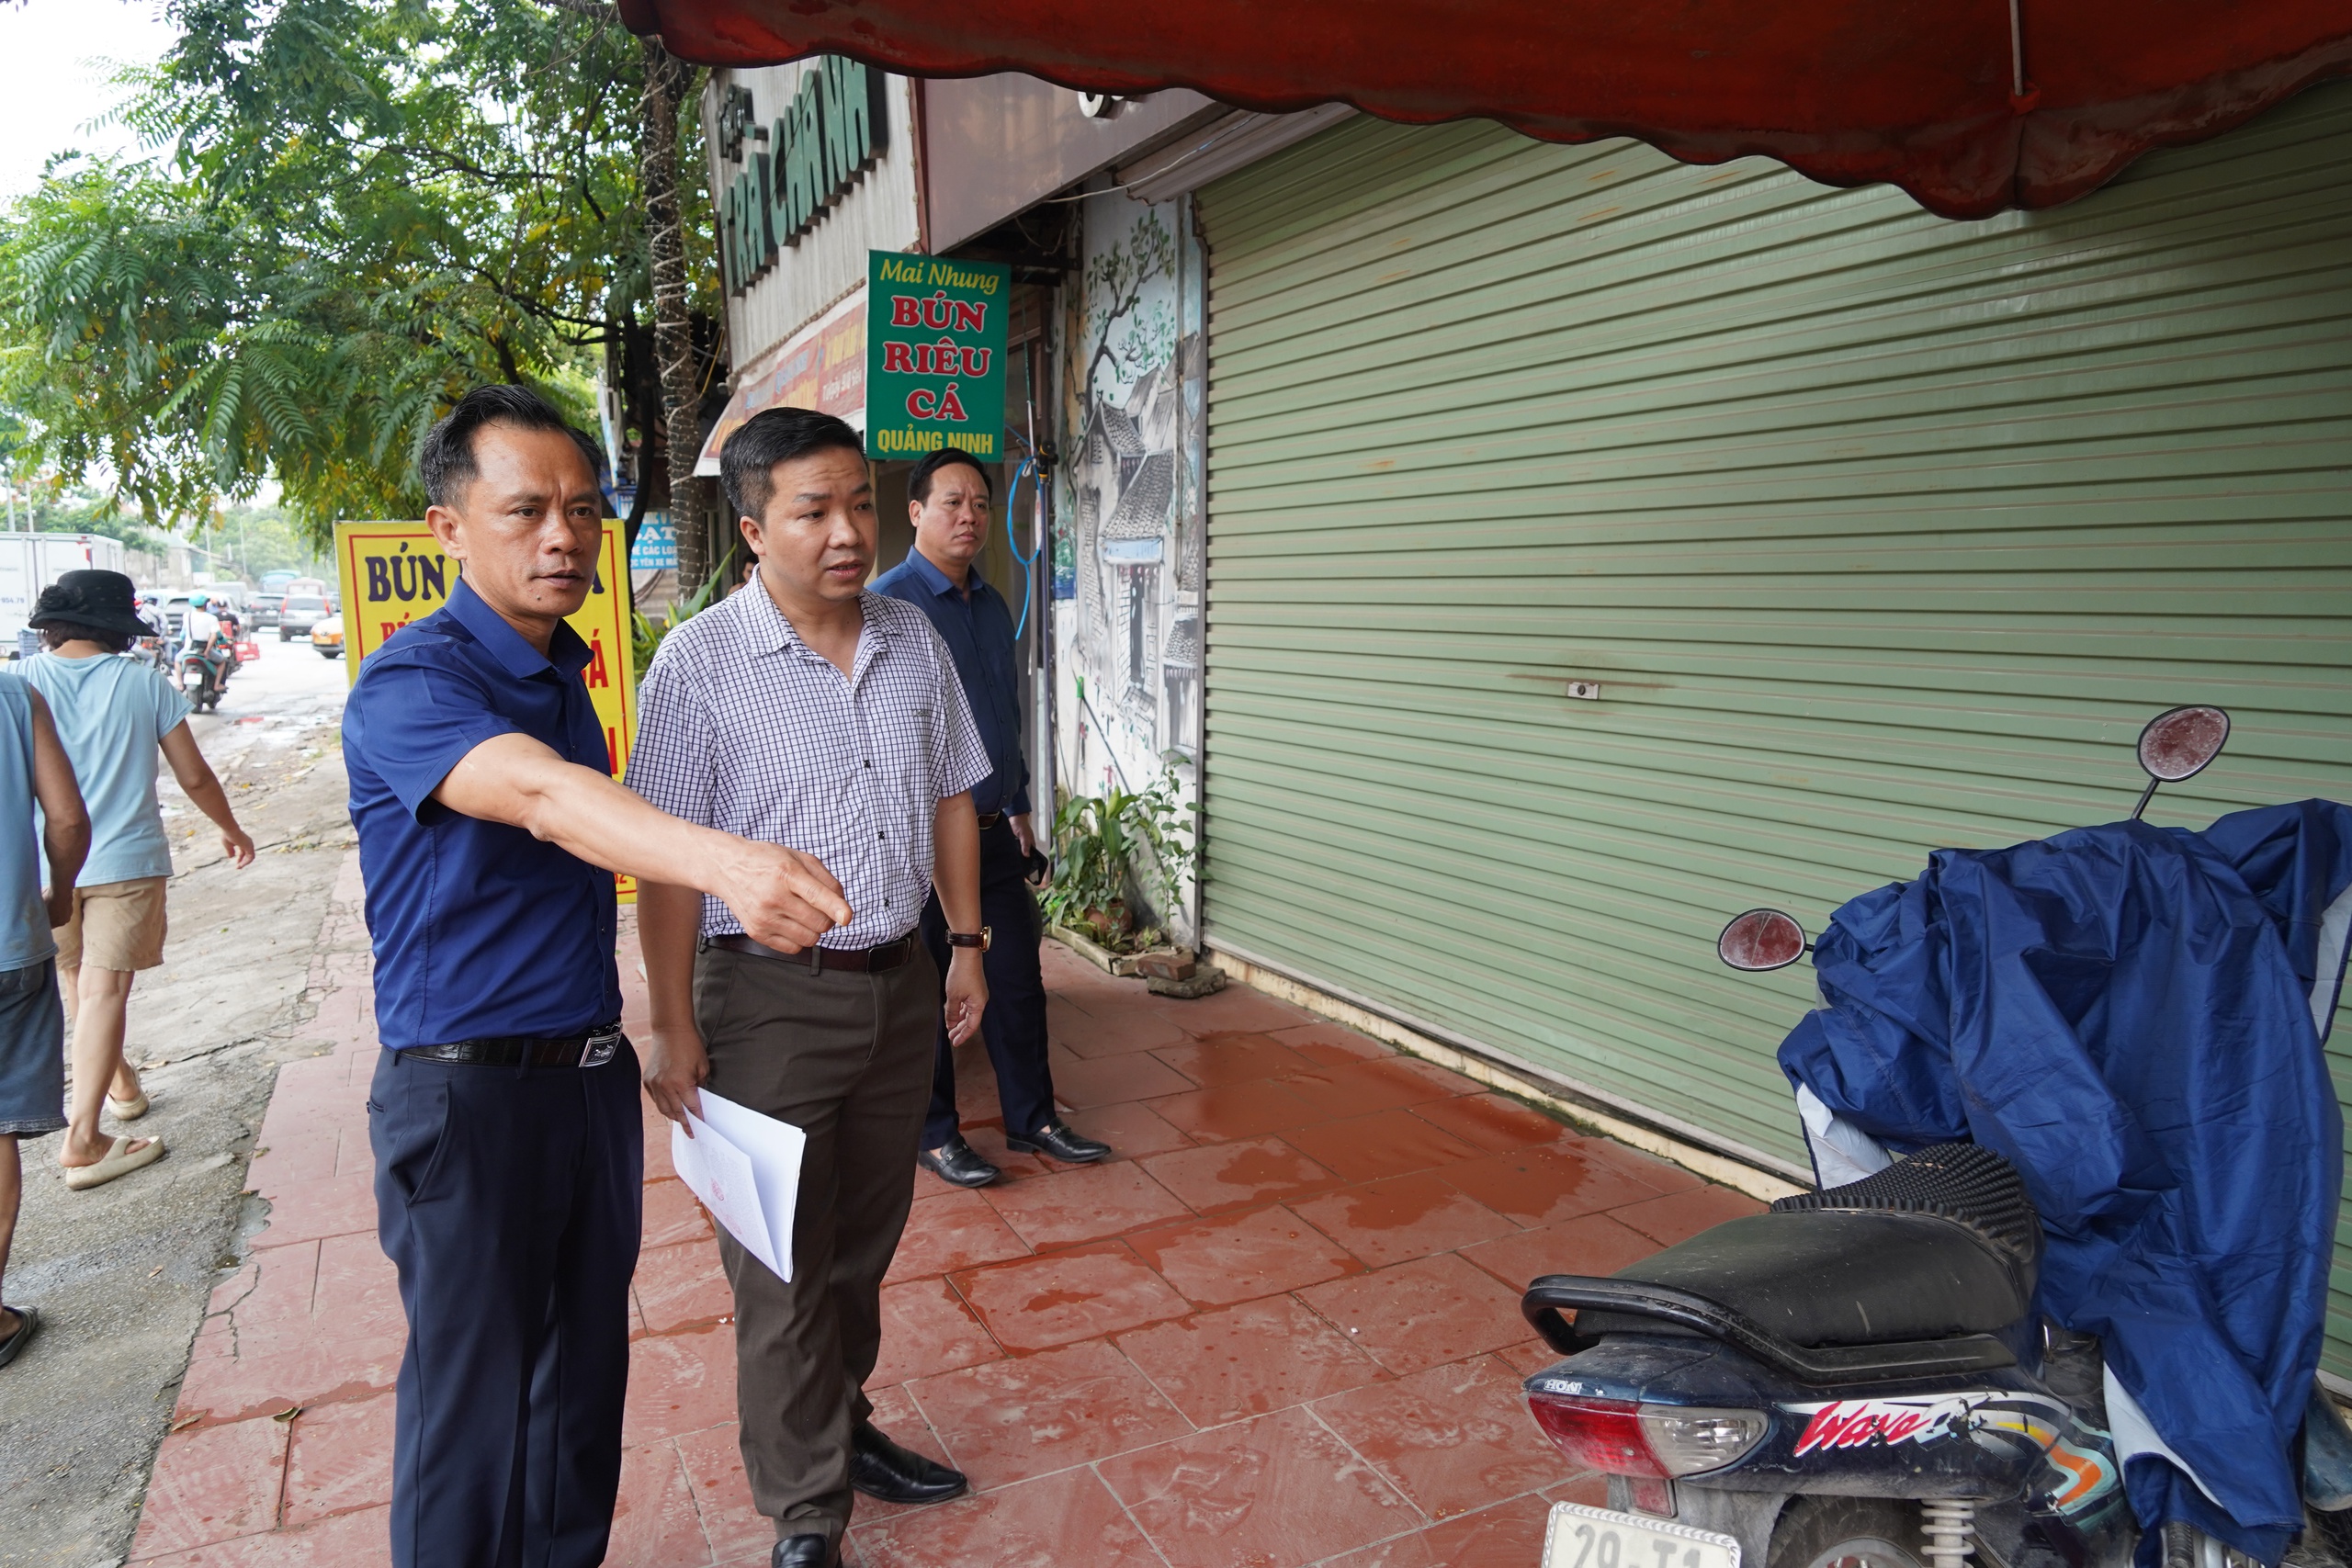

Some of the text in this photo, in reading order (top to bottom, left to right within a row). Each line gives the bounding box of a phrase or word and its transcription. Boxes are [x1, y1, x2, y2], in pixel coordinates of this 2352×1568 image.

[770, 56, 871, 247] CHANH
[880, 259, 1000, 295] Mai Nhung
[890, 290, 988, 333] BÚN
[882, 336, 992, 378] RIÊU
[906, 382, 968, 421] CÁ
[877, 423, 994, 454] QUẢNG NINH
[365, 541, 446, 602] BÚN
[1793, 1400, 1932, 1458] Wave
